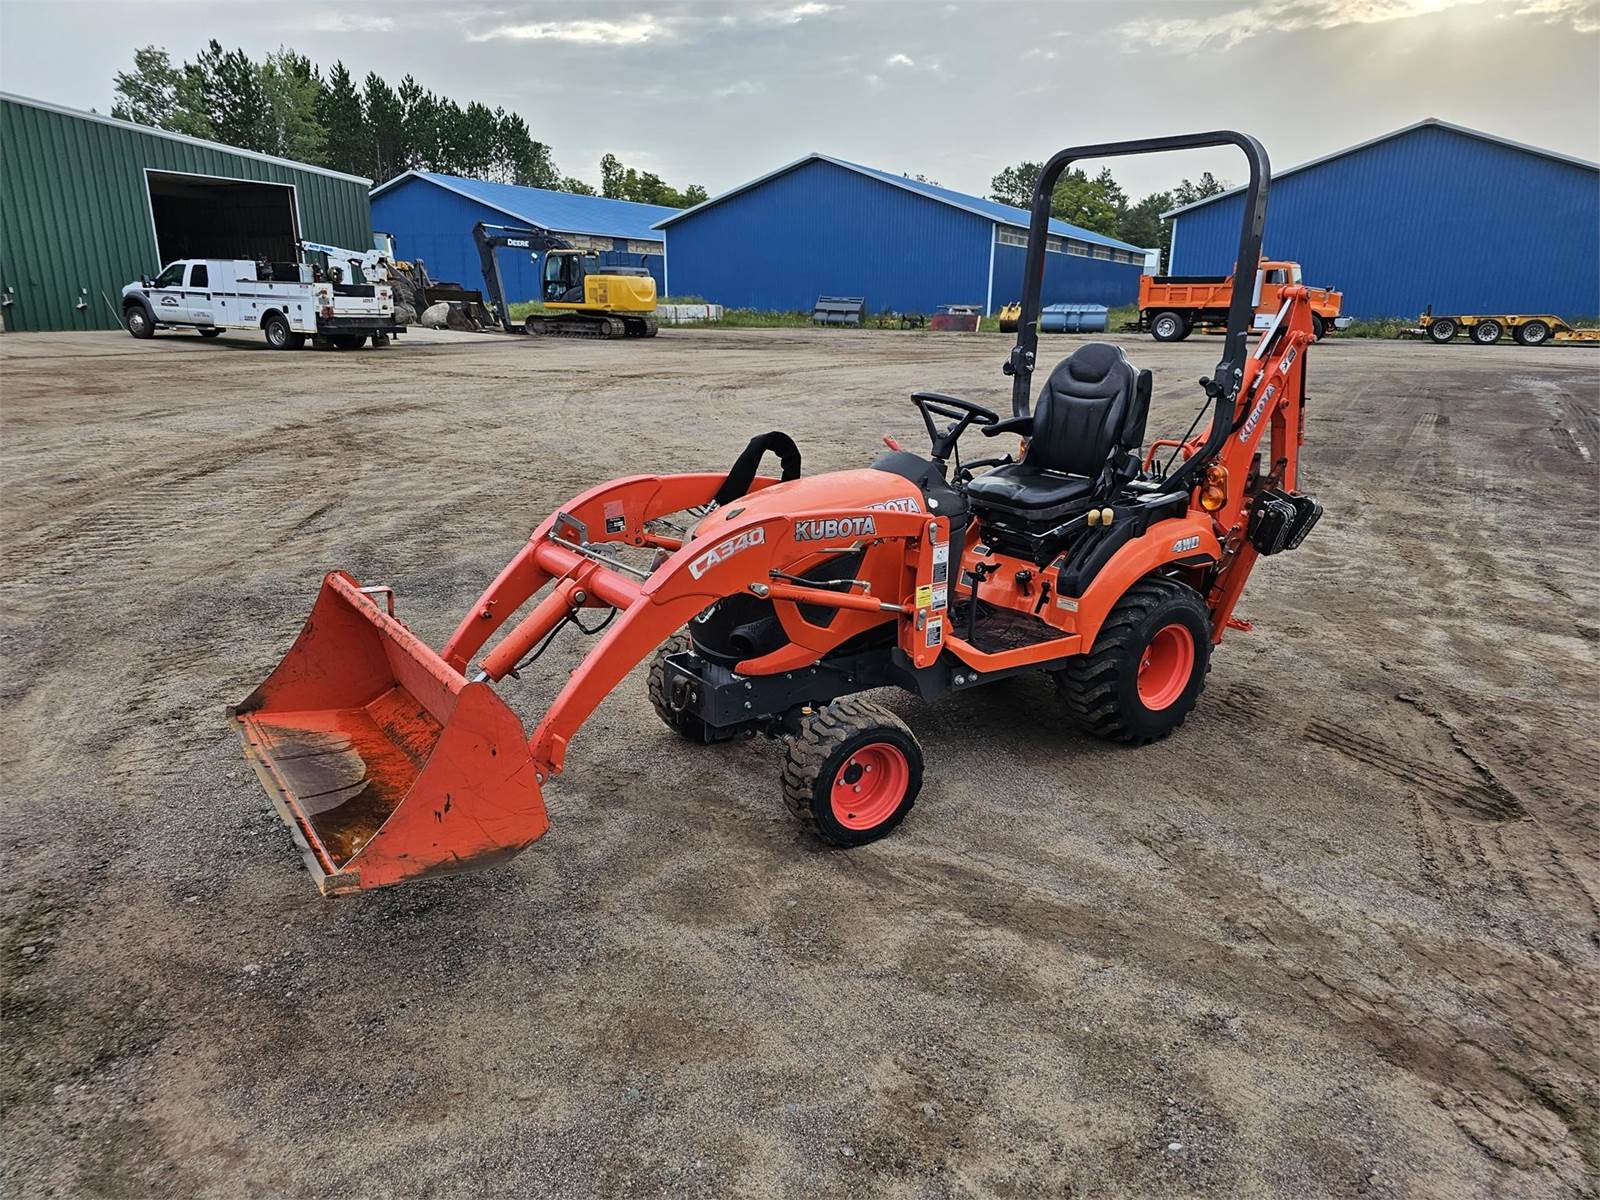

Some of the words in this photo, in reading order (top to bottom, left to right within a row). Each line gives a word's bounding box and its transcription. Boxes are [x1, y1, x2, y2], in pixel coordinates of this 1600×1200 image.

[507, 238, 530, 248] DEERE
[1240, 384, 1276, 443] KUBOTA
[795, 515, 877, 541] KUBOTA
[688, 527, 765, 580] CA340
[1172, 535, 1199, 553] 4WD
